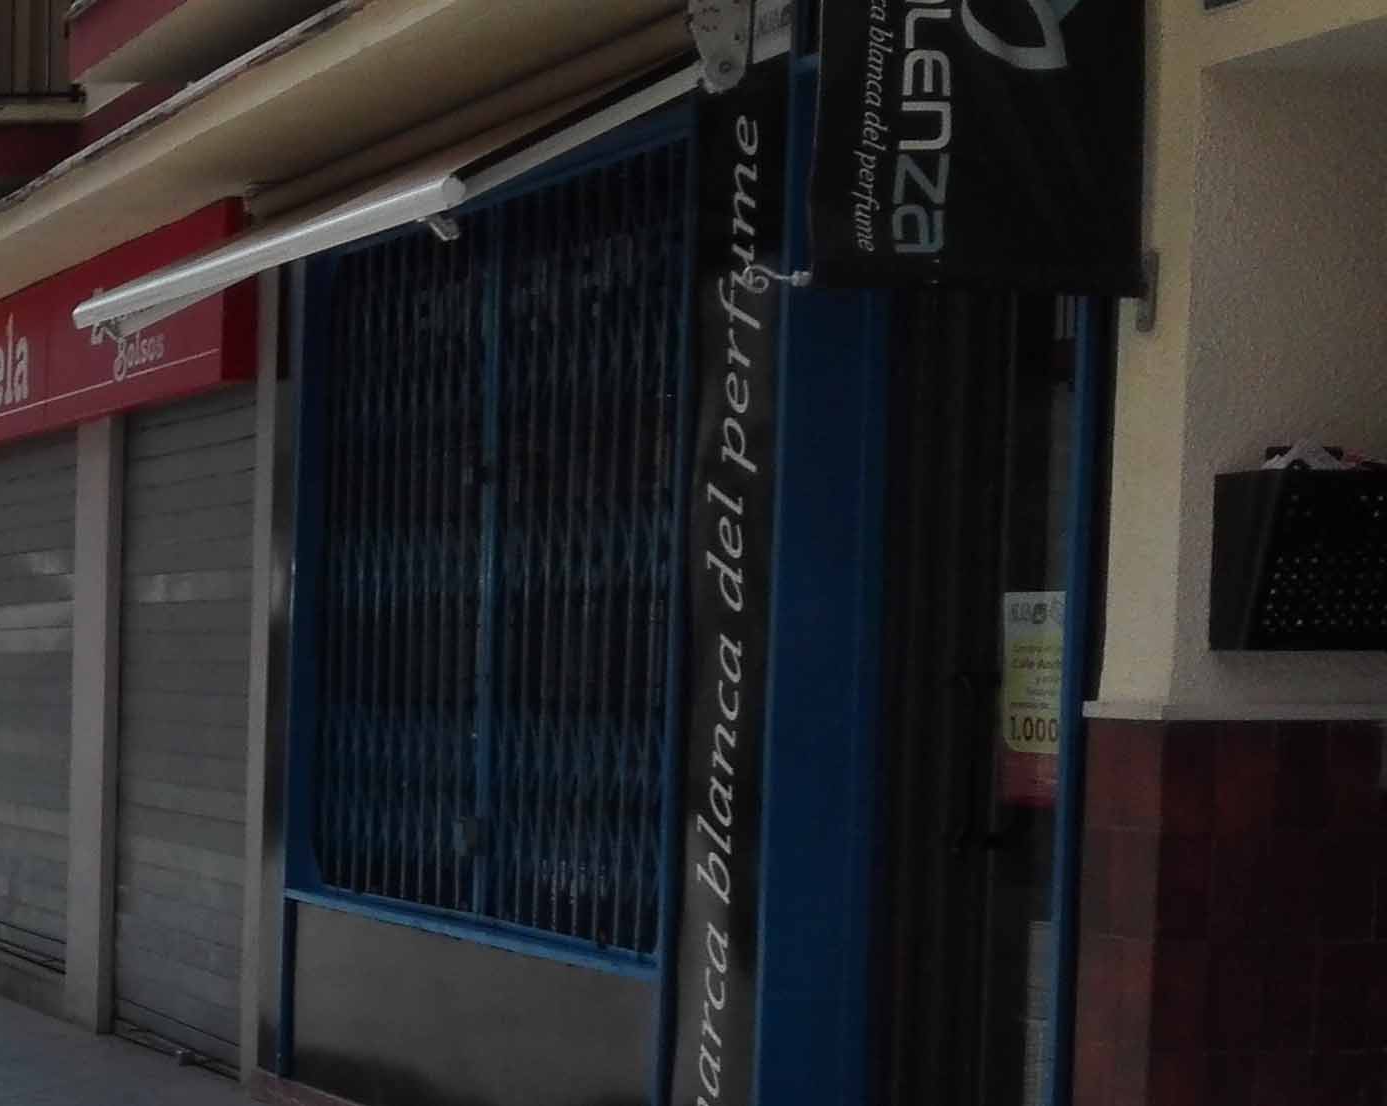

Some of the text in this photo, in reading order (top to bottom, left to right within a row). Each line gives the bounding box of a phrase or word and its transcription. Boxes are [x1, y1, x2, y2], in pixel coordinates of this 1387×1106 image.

[864, 25, 894, 107] blanca
[861, 110, 889, 152] del
[850, 149, 881, 253] perfume
[696, 114, 761, 1106] arca blanca del perfume
